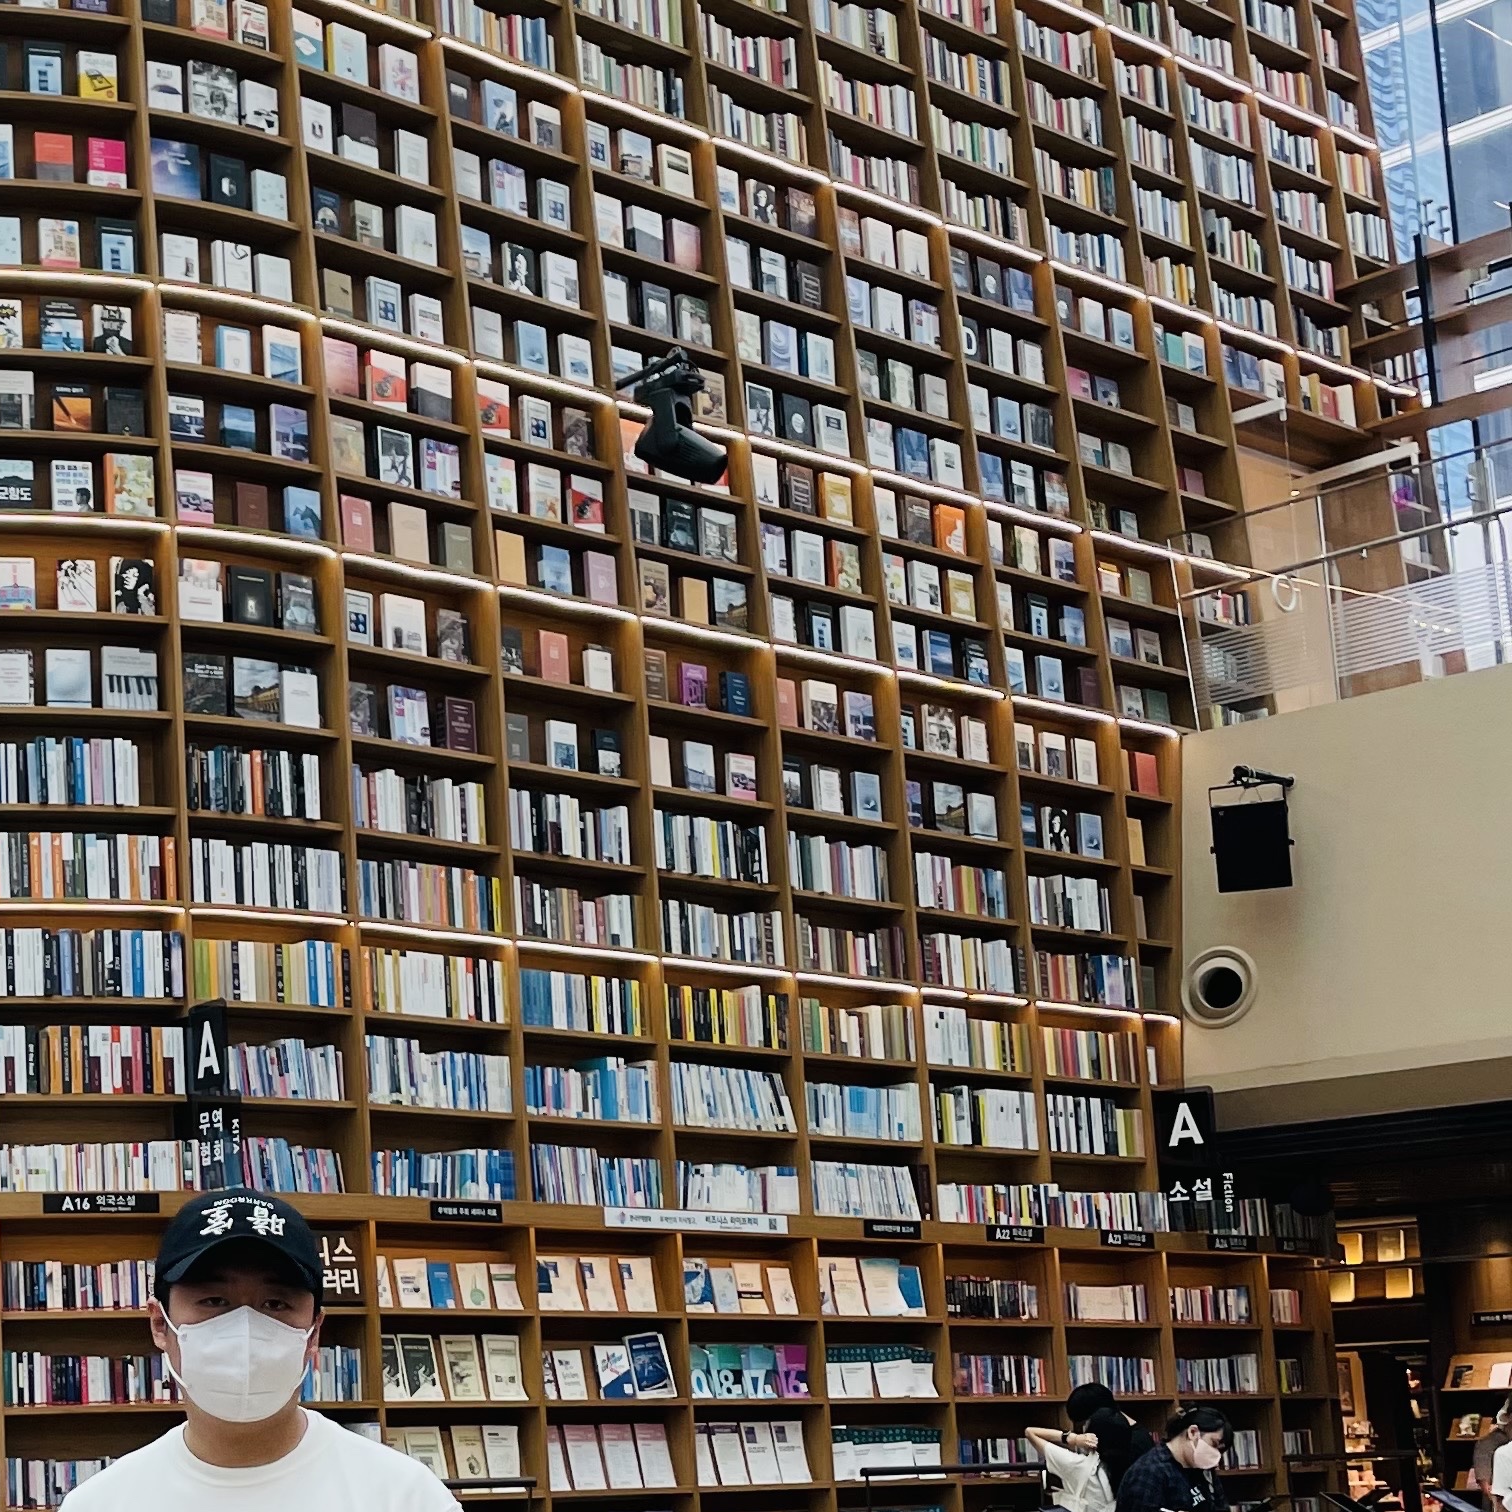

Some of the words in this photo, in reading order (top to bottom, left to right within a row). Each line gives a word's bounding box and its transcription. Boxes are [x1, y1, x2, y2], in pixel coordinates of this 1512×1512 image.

[197, 1021, 221, 1079] A
[1168, 1102, 1205, 1147] A
[1169, 1178, 1213, 1202] 소설
[1222, 1172, 1235, 1213] Fiction
[61, 1196, 91, 1211] A16
[95, 1195, 136, 1207] 외국소설
[995, 1228, 1011, 1240] A22
[1107, 1233, 1122, 1245] A23
